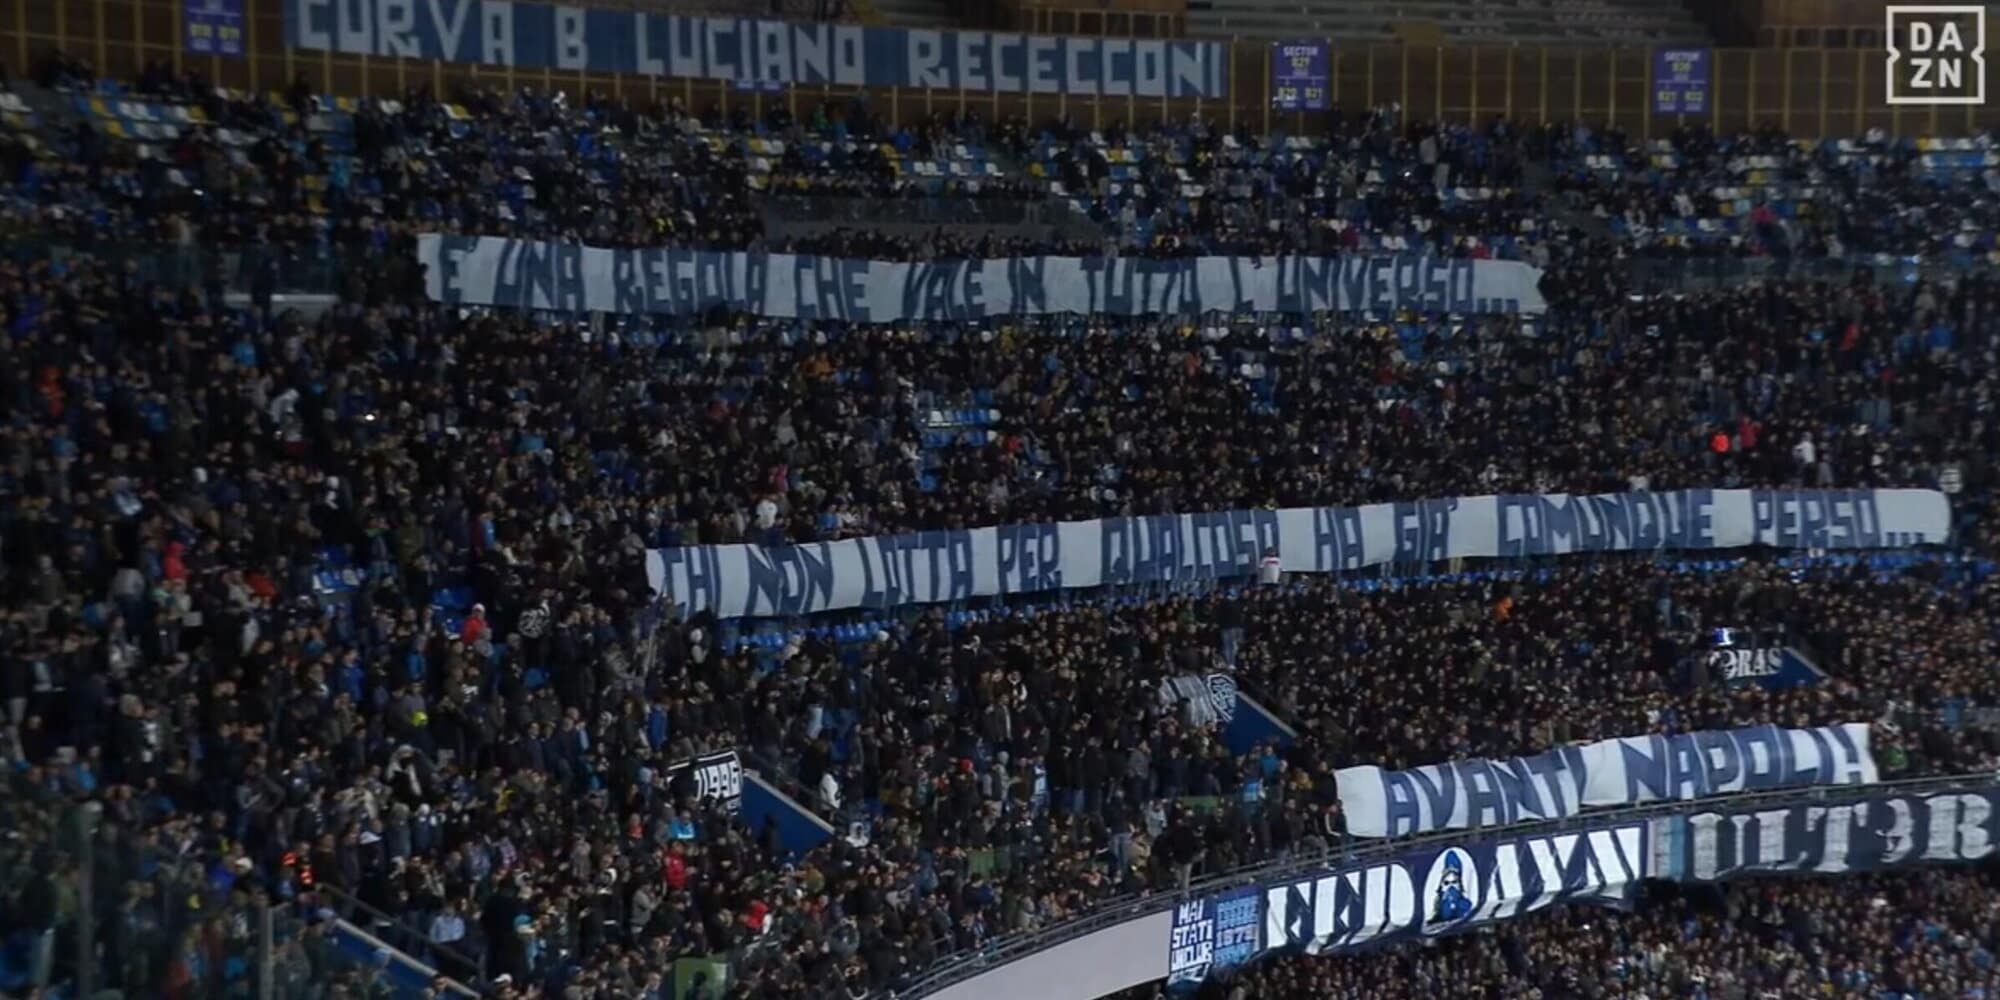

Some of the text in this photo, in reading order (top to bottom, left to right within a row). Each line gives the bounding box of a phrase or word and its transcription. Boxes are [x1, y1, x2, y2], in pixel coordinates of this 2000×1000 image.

[297, 0, 515, 67] CURVA
[555, 6, 589, 71] B
[634, 12, 867, 86] LUCIANO
[908, 30, 1221, 98] RECECCONI
[494, 239, 588, 314] UNA
[612, 248, 769, 318] REGOLA
[794, 254, 871, 324] CHE
[903, 256, 985, 322] VALE
[1007, 252, 1047, 315] IN
[1080, 253, 1200, 317] TUTTO
[661, 544, 722, 623] CHI
[744, 540, 835, 617] NON
[857, 527, 975, 606] LOTTA
[997, 522, 1062, 593] PER
[1314, 503, 1364, 573] HA
[1498, 490, 1714, 557] COMUNQUE
[1381, 722, 1863, 837] AVANTI NAPOLI!
[1172, 919, 1213, 949] STATI
[1179, 899, 1204, 926] MAI
